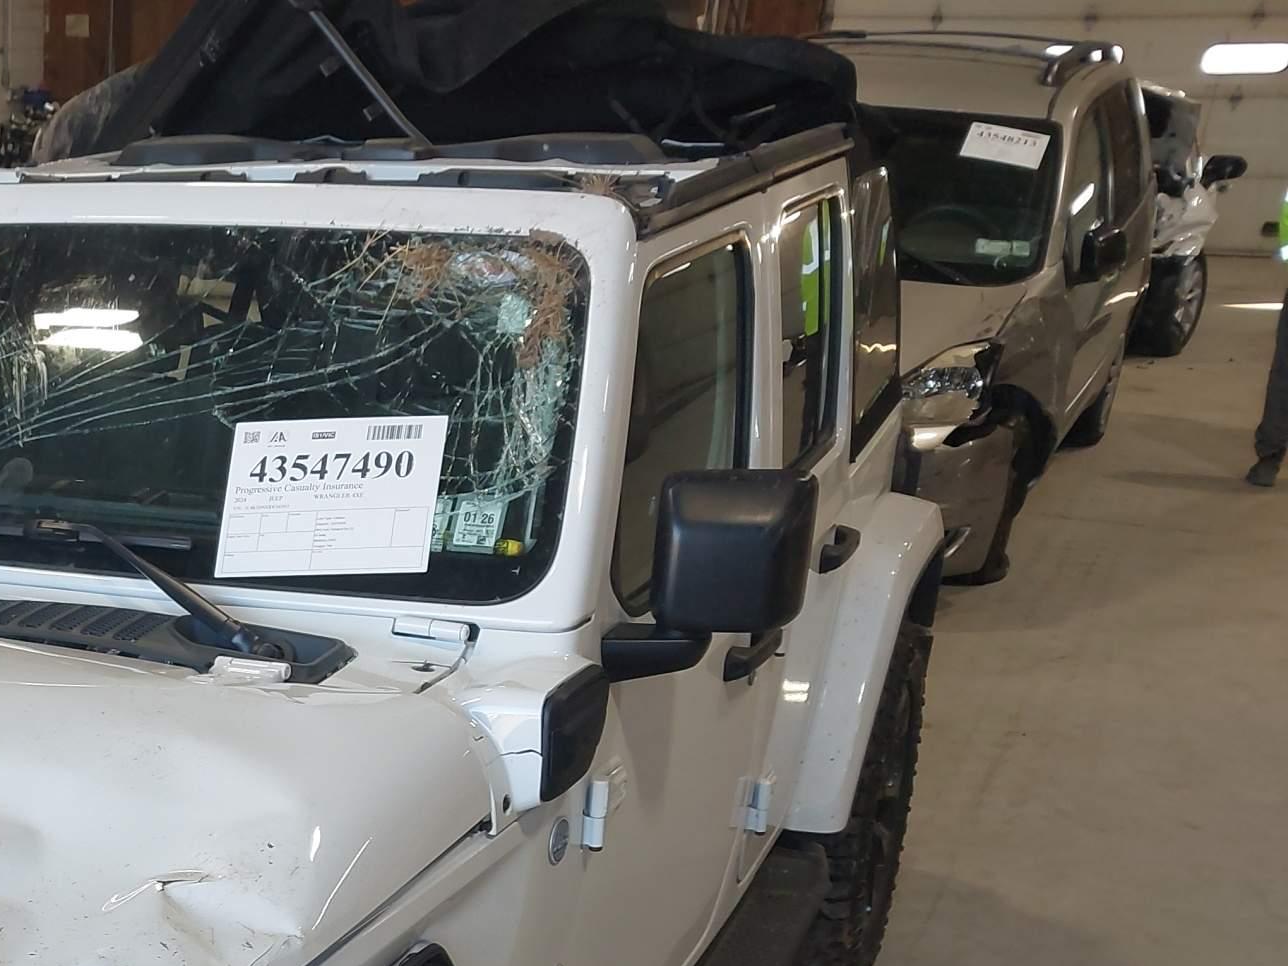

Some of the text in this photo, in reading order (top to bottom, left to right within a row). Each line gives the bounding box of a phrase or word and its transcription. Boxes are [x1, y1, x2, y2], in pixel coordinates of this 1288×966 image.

[249, 450, 414, 483] 43547490
[235, 482, 364, 496] Progressive Casualty Insurance
[464, 512, 495, 524] 01 26
